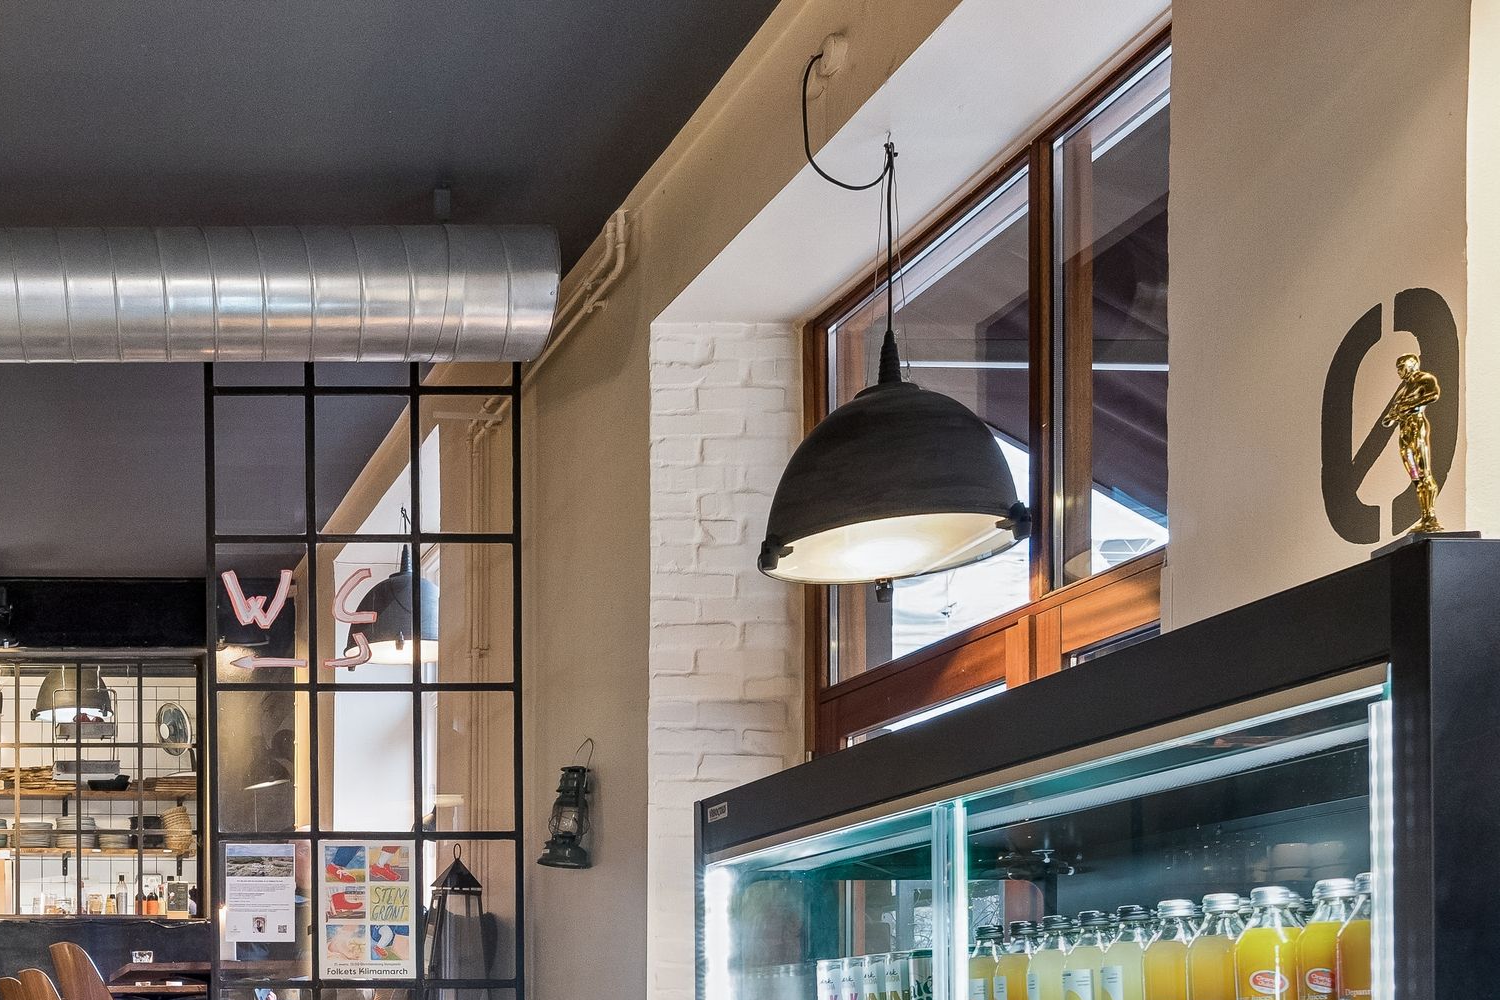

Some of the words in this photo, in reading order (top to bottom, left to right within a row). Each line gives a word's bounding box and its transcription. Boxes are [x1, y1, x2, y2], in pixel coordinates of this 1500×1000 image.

[372, 887, 408, 904] STEM
[372, 904, 408, 920] GRØNT
[327, 967, 356, 975] Folkets
